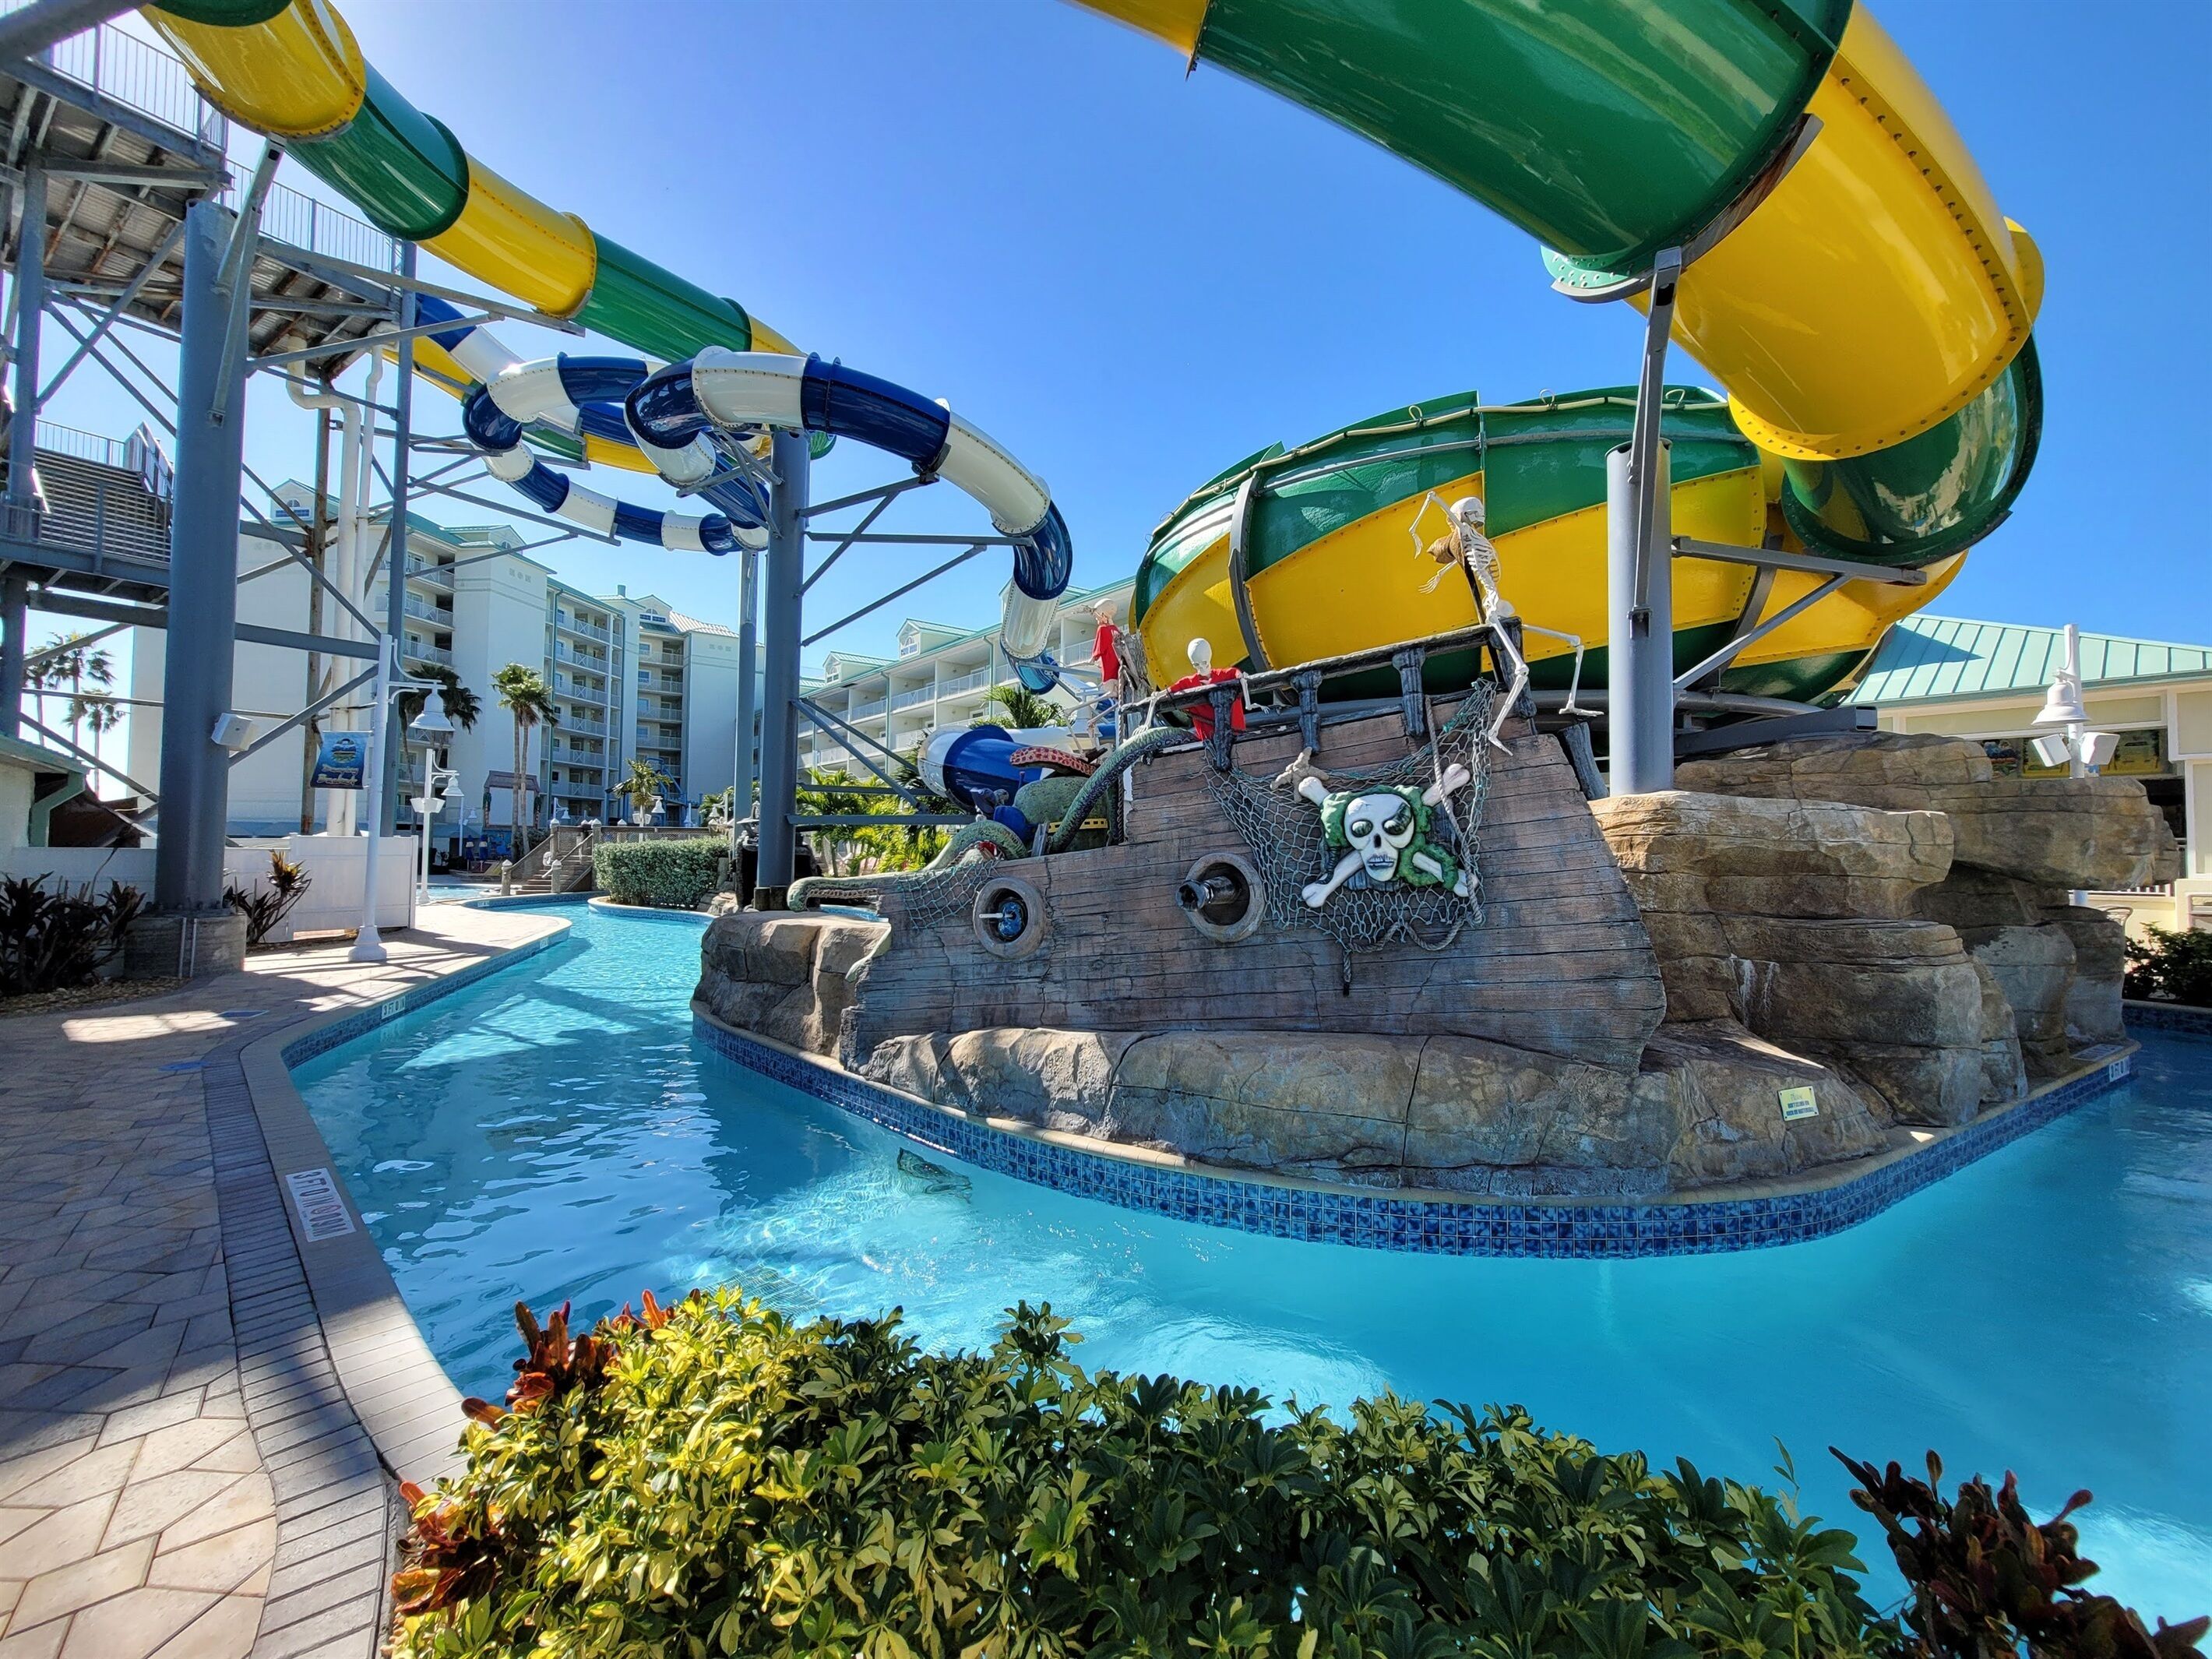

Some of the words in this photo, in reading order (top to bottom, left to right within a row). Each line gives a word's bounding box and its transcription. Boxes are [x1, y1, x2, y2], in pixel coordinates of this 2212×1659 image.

[293, 1171, 322, 1180] 3
[294, 1178, 327, 1189] FT
[299, 1188, 330, 1197] 0
[302, 1196, 336, 1208] IN
